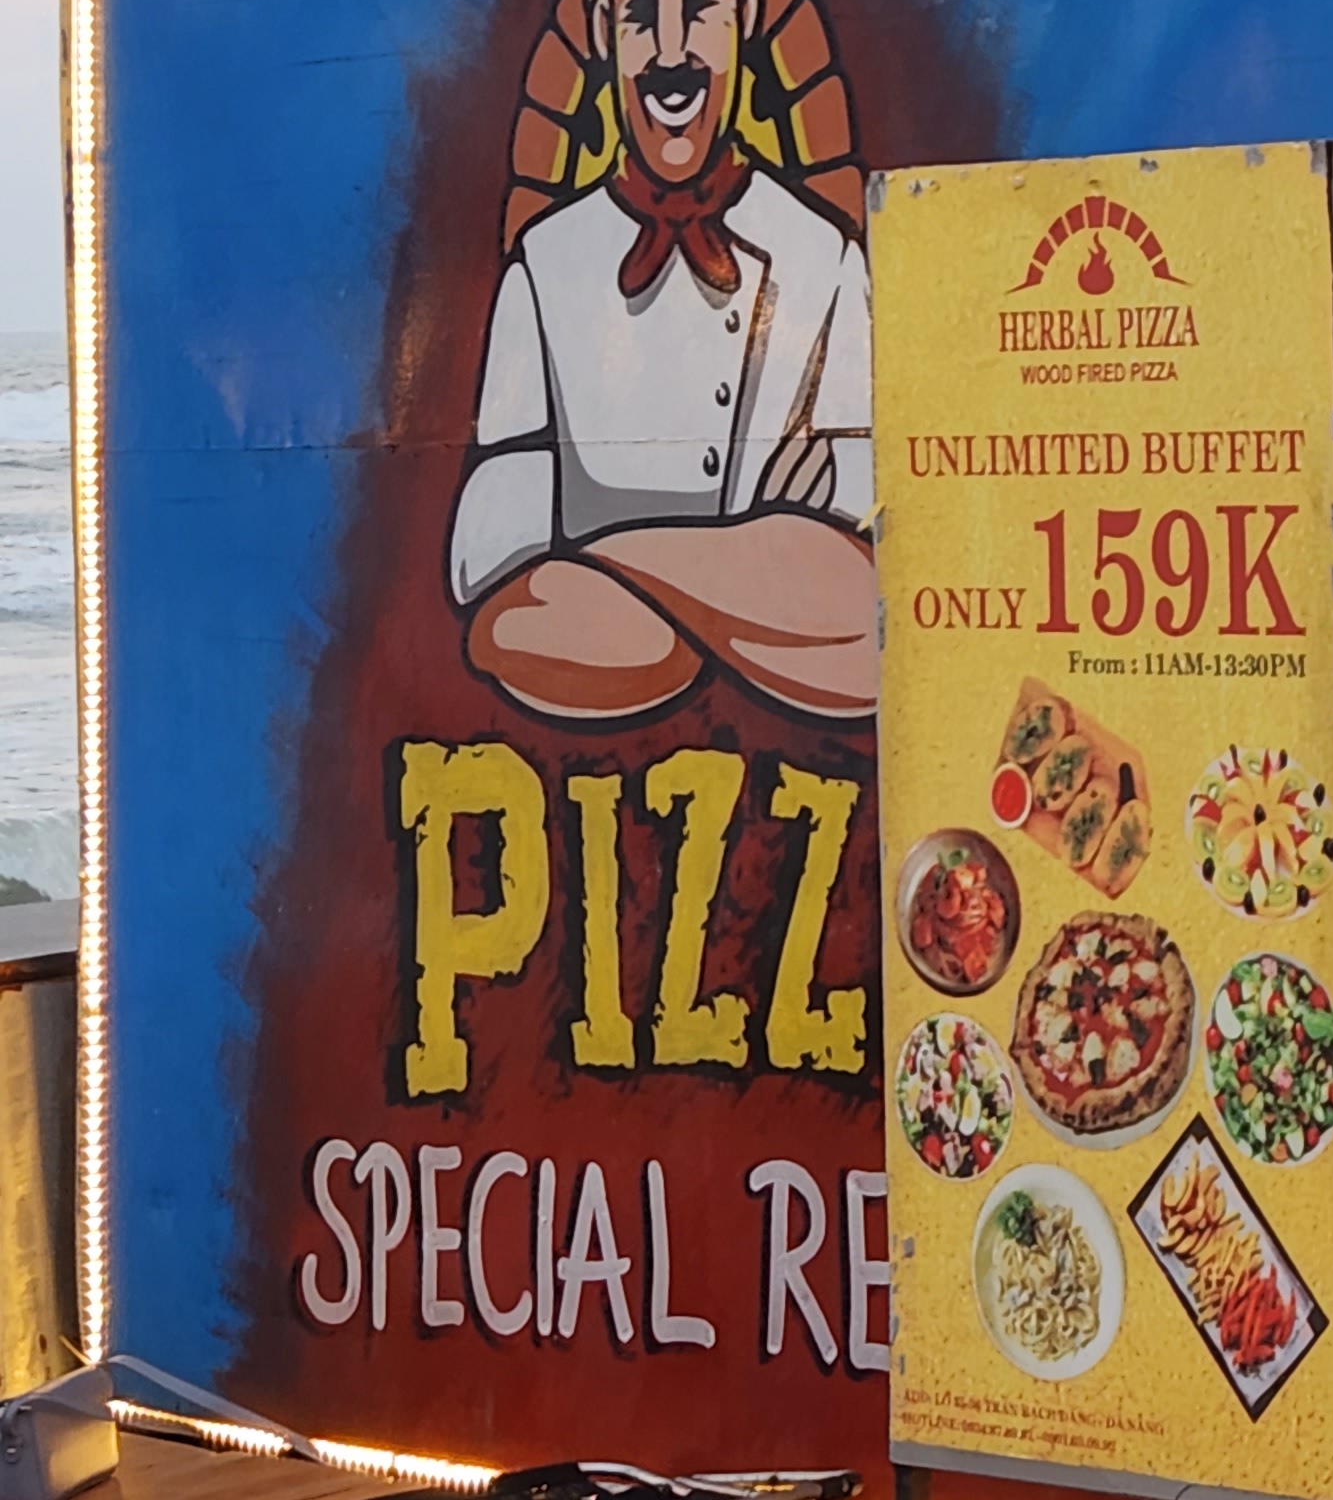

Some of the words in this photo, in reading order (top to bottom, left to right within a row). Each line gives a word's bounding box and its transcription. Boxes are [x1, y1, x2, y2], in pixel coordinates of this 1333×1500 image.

[998, 307, 1112, 353] HERBAL
[1117, 304, 1200, 349] PIZZA
[1019, 364, 1074, 385] WOOD
[1077, 362, 1126, 384] FIRED
[1130, 361, 1179, 382] PIZZA
[906, 432, 1130, 478] UNLIMITED
[1141, 429, 1306, 476] BUFFET
[912, 586, 1027, 630] ONLY
[1033, 503, 1308, 638] 159K
[1067, 650, 1125, 677] From
[1144, 651, 1307, 679] 11AM-13:30PM
[299, 1136, 717, 1350] SPECIAL
[749, 1157, 892, 1372] RE
